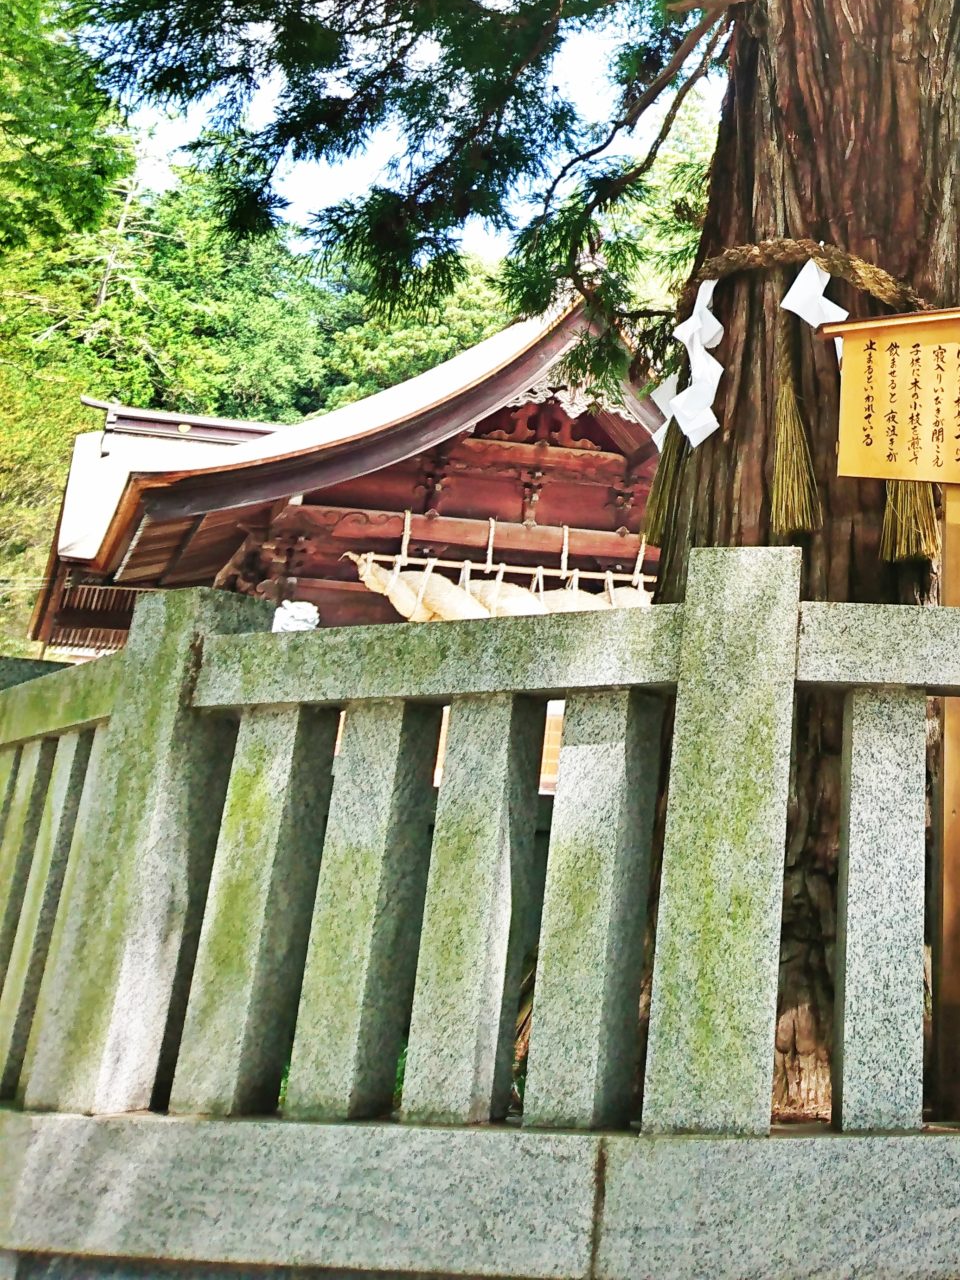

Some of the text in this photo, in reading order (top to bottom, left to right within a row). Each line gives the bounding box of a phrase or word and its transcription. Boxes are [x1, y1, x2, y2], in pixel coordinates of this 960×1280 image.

[862, 339, 877, 446] 止まるといわれている
[907, 342, 923, 465] 子供に木の小枝を煎じて
[931, 344, 947, 468] 寝入りいびきが聞こえ
